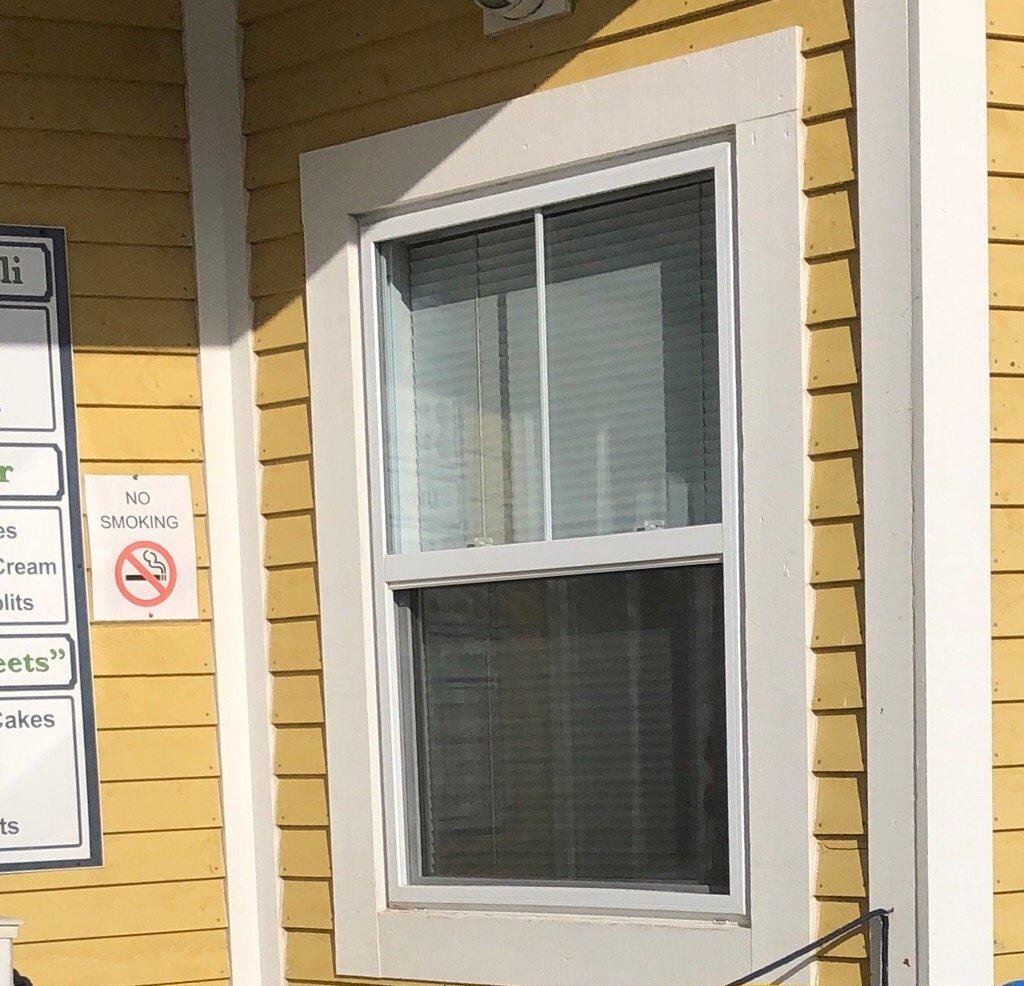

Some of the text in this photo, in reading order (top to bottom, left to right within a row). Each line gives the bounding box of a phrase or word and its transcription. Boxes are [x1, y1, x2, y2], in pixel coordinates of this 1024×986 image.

[125, 491, 150, 505] NO
[100, 515, 179, 529] SMOKING
[0, 709, 56, 728] akes
